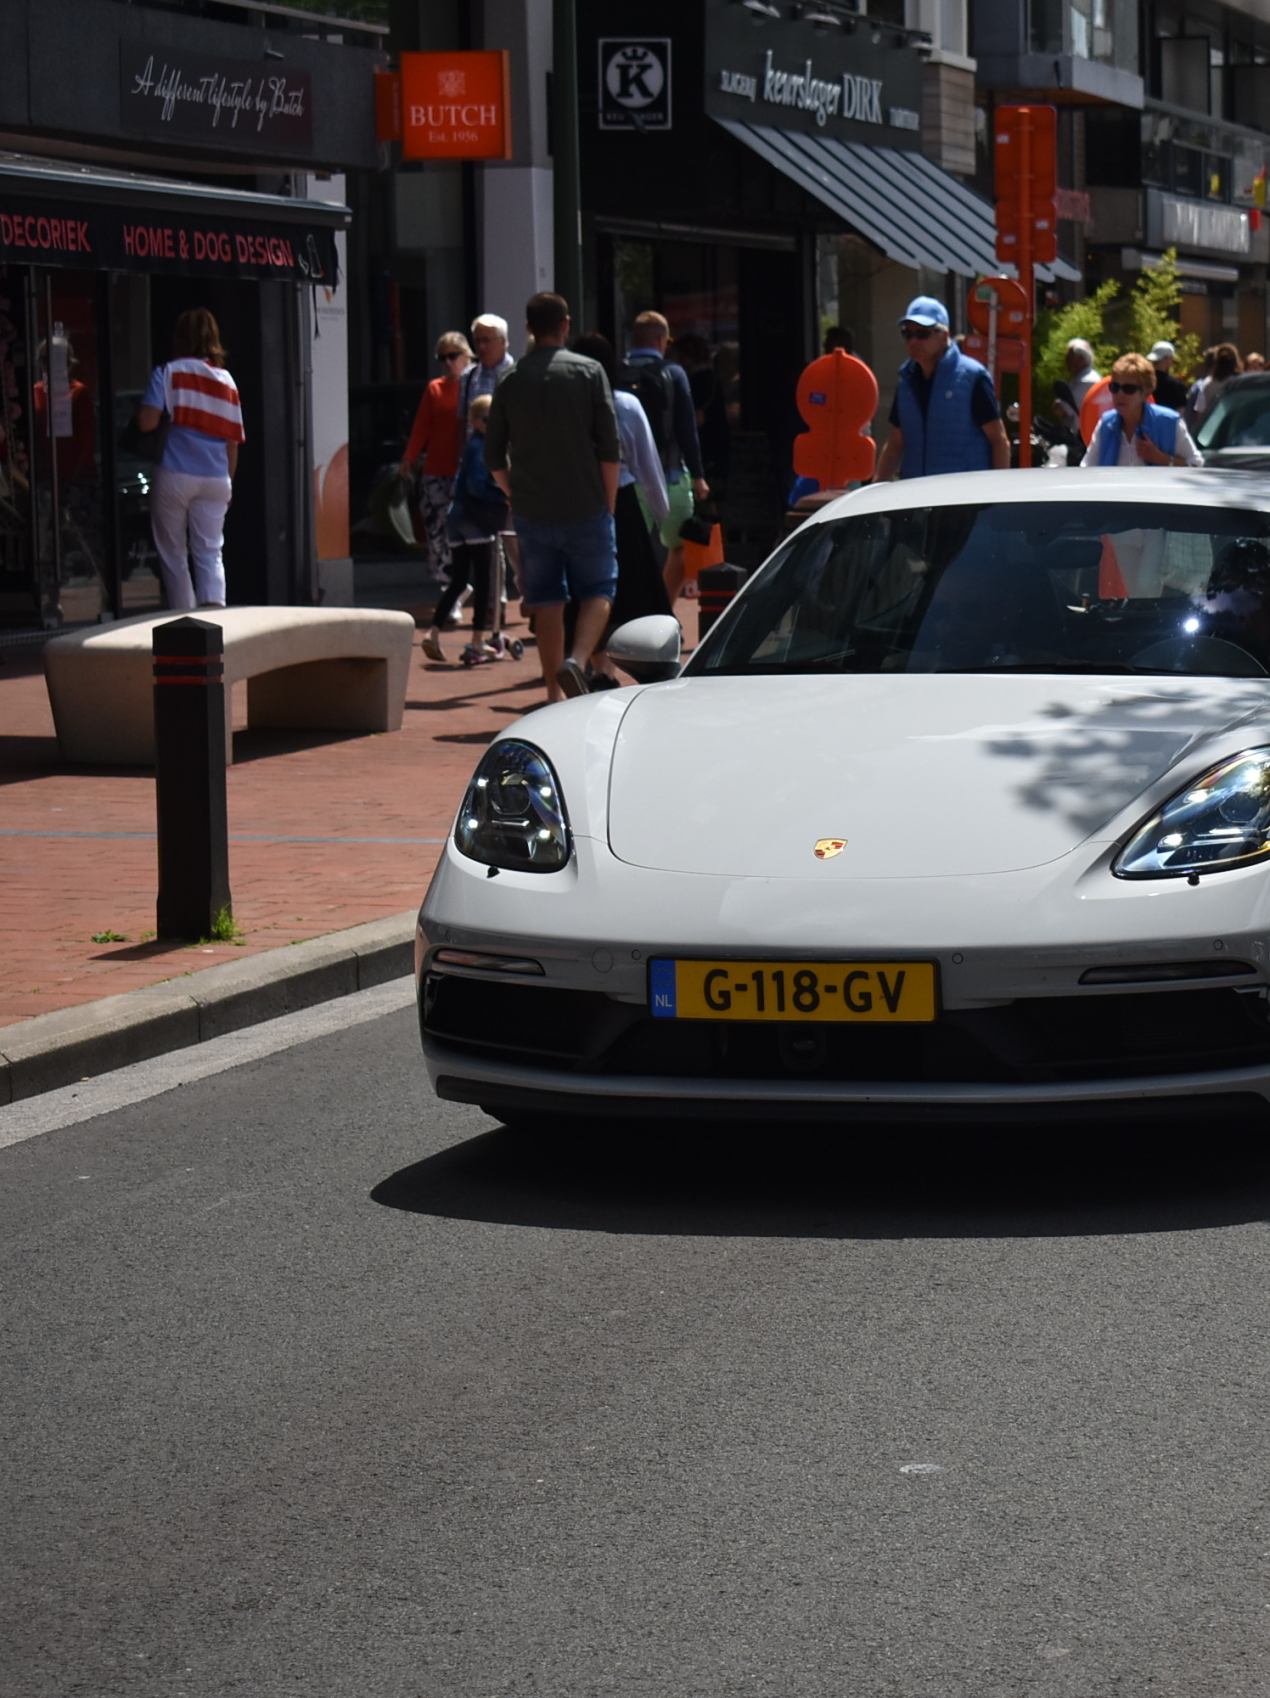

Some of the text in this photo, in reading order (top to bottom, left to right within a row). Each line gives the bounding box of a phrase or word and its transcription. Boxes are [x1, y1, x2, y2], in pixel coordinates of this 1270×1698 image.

[131, 55, 304, 131] A different lifestyle by Butch
[615, 63, 654, 99] K
[763, 49, 842, 126] keurslager
[843, 73, 883, 125] DIRK
[410, 105, 496, 126] BUTCH
[453, 131, 478, 142] 1956
[0, 213, 294, 268] DECORIEK HOME & DOG DESIGN
[655, 994, 673, 1007] NL
[703, 968, 906, 1013] G-118-GV
